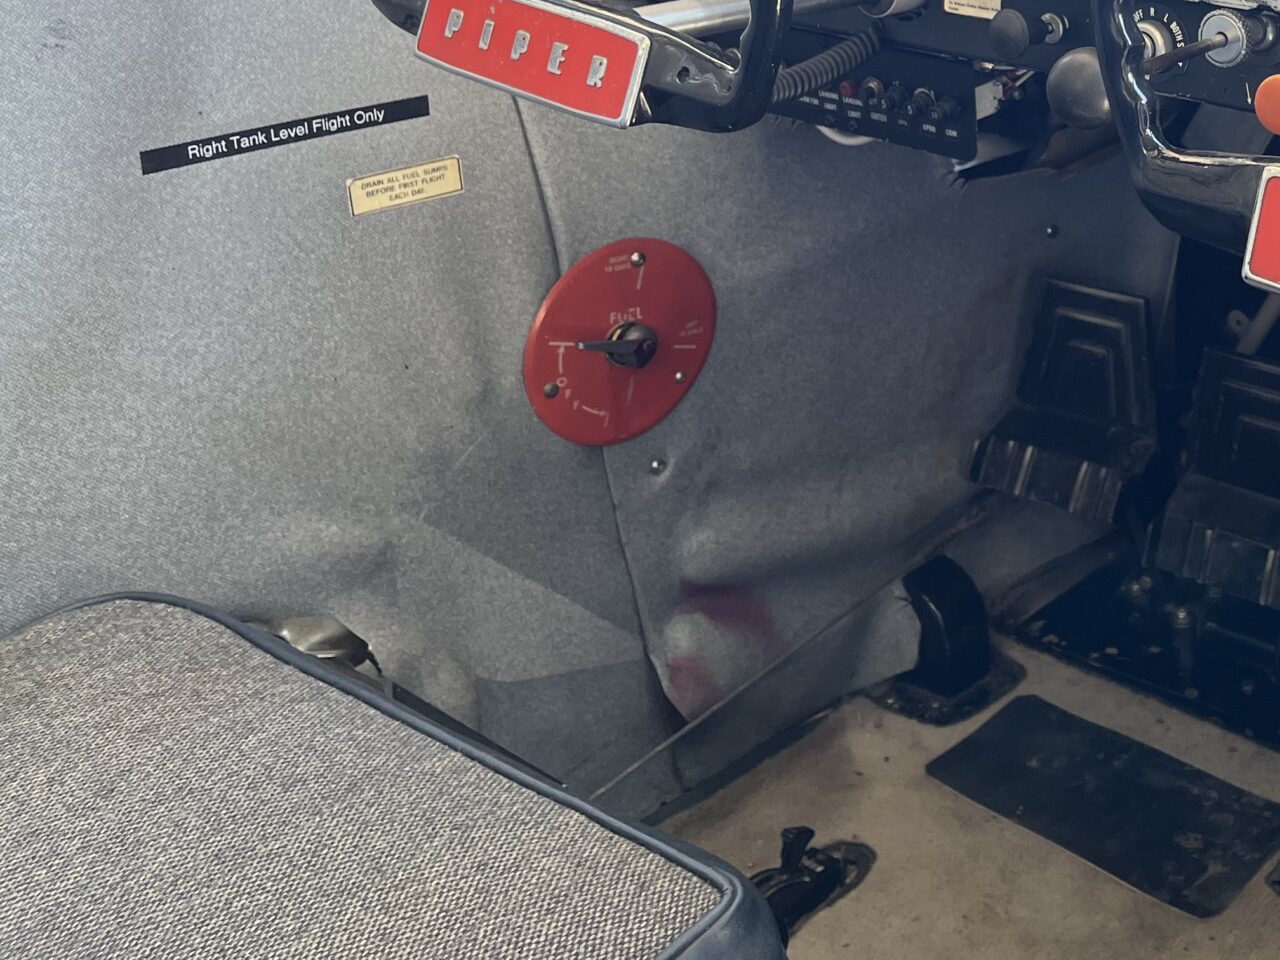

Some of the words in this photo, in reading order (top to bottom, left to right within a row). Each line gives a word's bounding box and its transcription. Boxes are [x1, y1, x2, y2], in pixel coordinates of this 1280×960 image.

[1170, 21, 1183, 41] BOTH
[444, 7, 608, 88] PIPER
[187, 140, 227, 160] Right
[230, 132, 266, 149] Tank
[271, 122, 308, 142] Level
[312, 112, 351, 133] Flight
[355, 108, 385, 124] Only
[361, 180, 384, 190] DRAIN
[402, 172, 420, 180] FUEL
[366, 186, 395, 198] BEFORE
[398, 181, 418, 190] FIRST
[421, 174, 446, 185] FLIGHT
[389, 192, 410, 201] EACH
